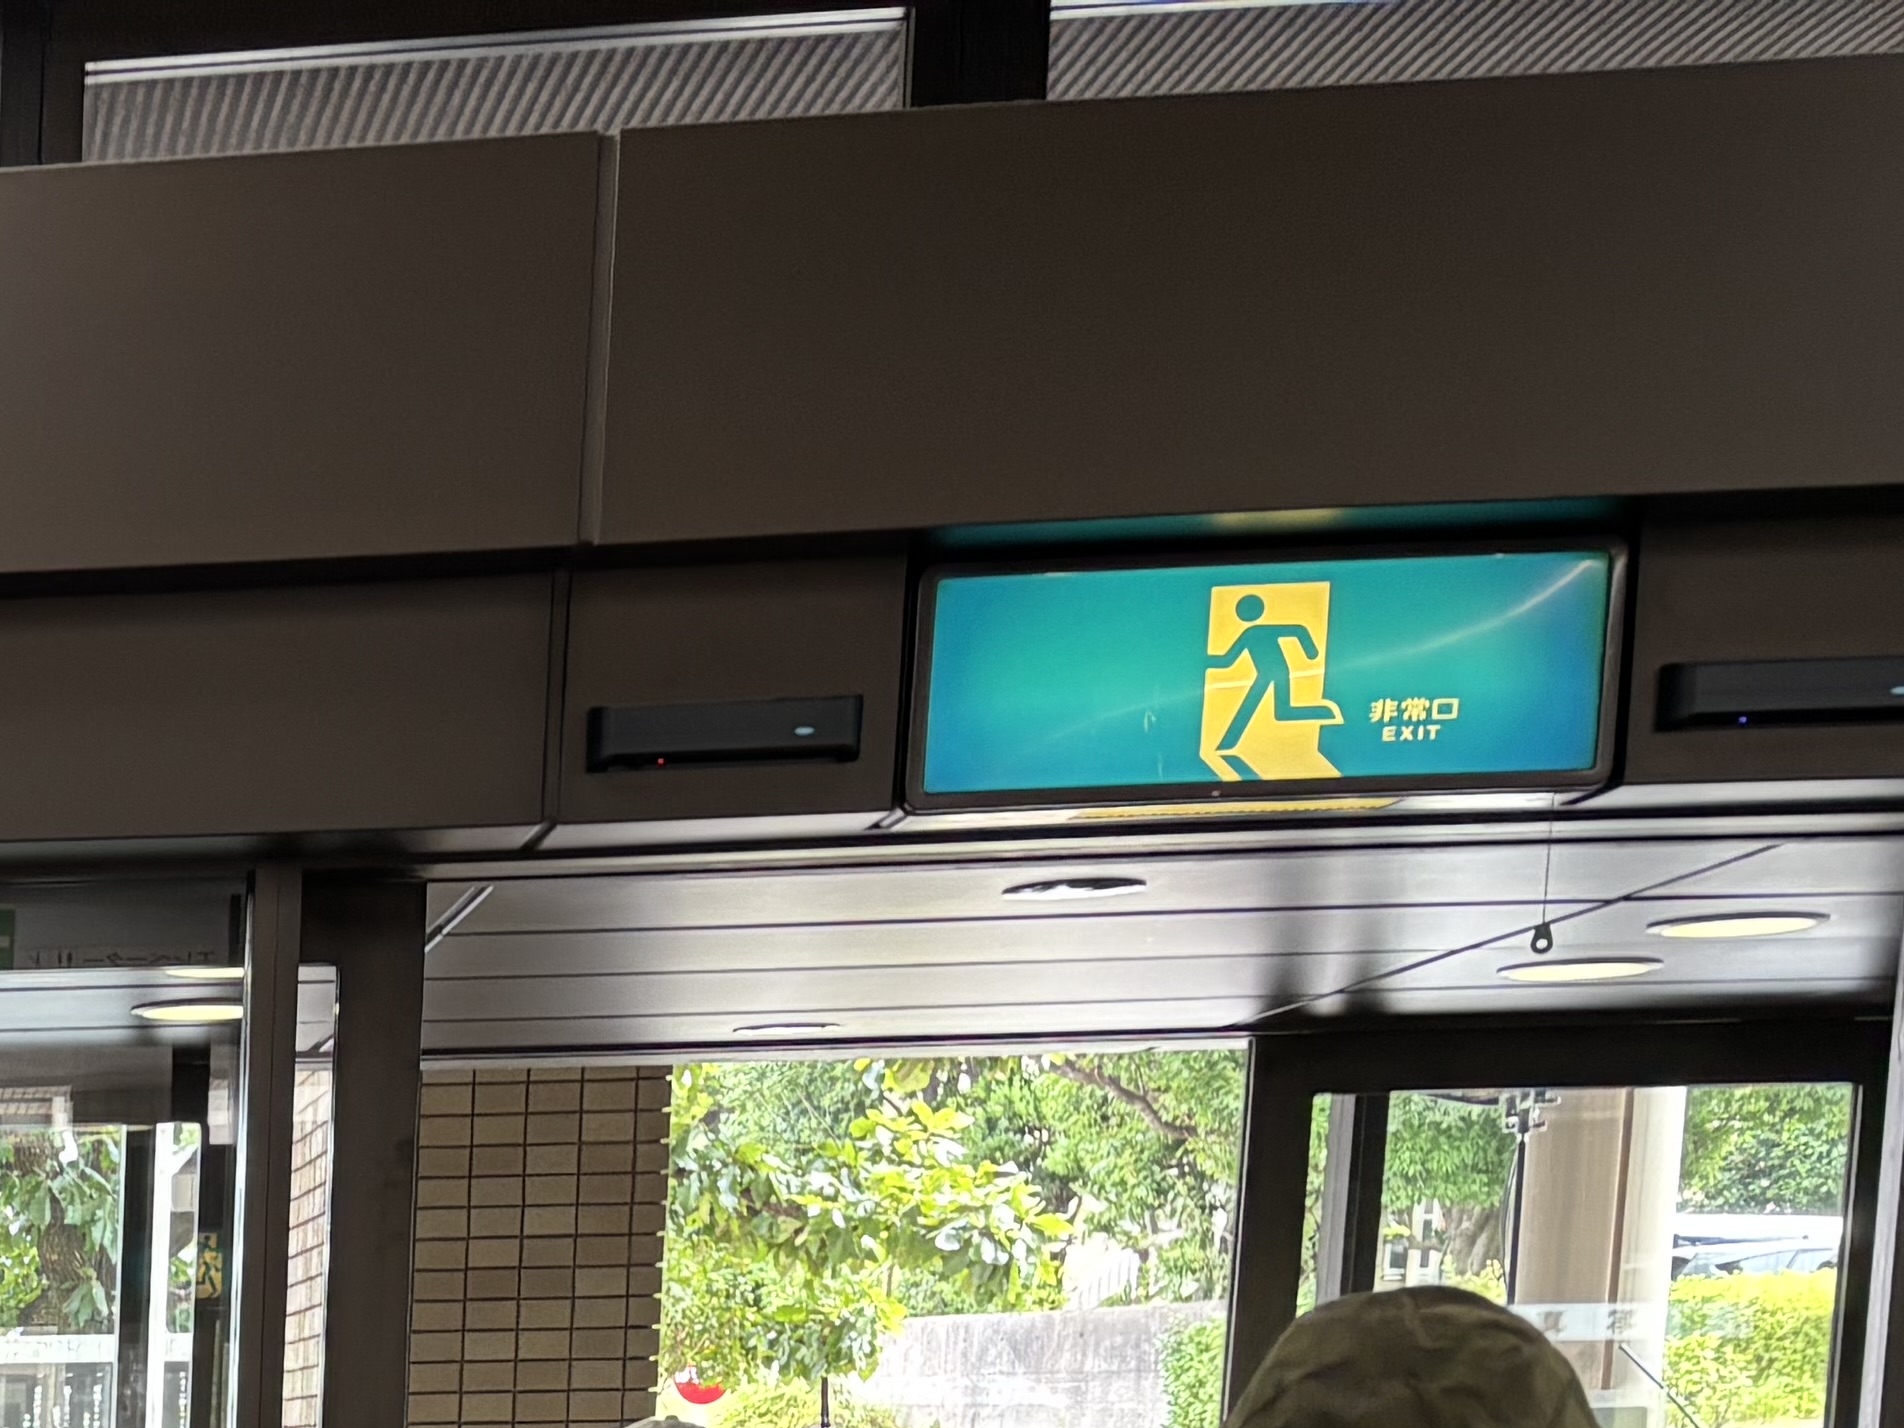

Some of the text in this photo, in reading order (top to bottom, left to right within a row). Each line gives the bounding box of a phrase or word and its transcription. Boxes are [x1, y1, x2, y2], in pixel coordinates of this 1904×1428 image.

[1369, 697, 1461, 723] 非常口
[1382, 724, 1441, 742] EXIT
